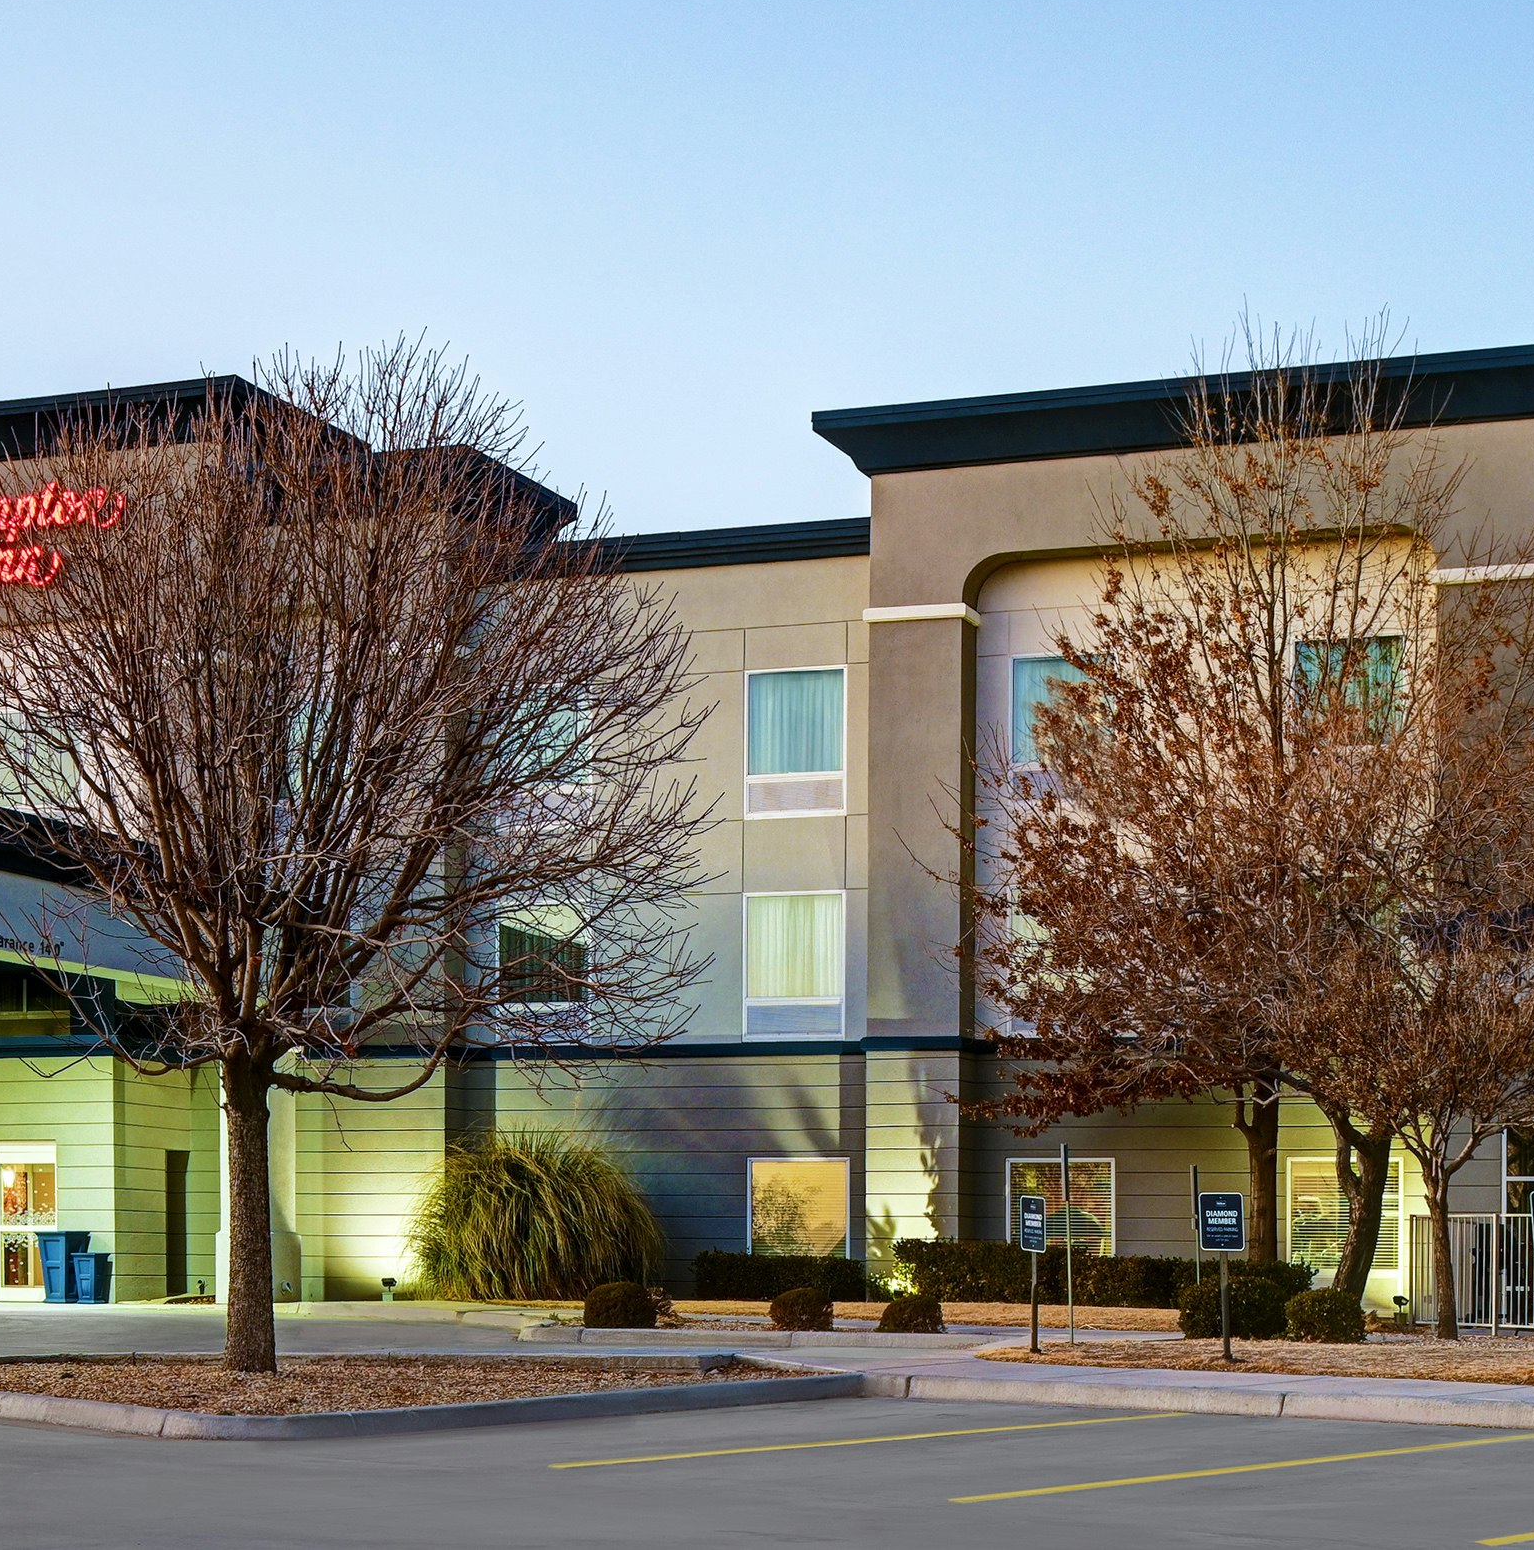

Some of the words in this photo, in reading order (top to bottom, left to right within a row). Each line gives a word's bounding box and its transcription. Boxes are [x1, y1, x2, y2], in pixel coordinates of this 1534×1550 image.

[1024, 1212, 1043, 1221] DIAMOND
[1205, 1210, 1238, 1218] DIAMOND
[1025, 1219, 1042, 1227] MEMBER
[1207, 1217, 1237, 1225] MEMBER
